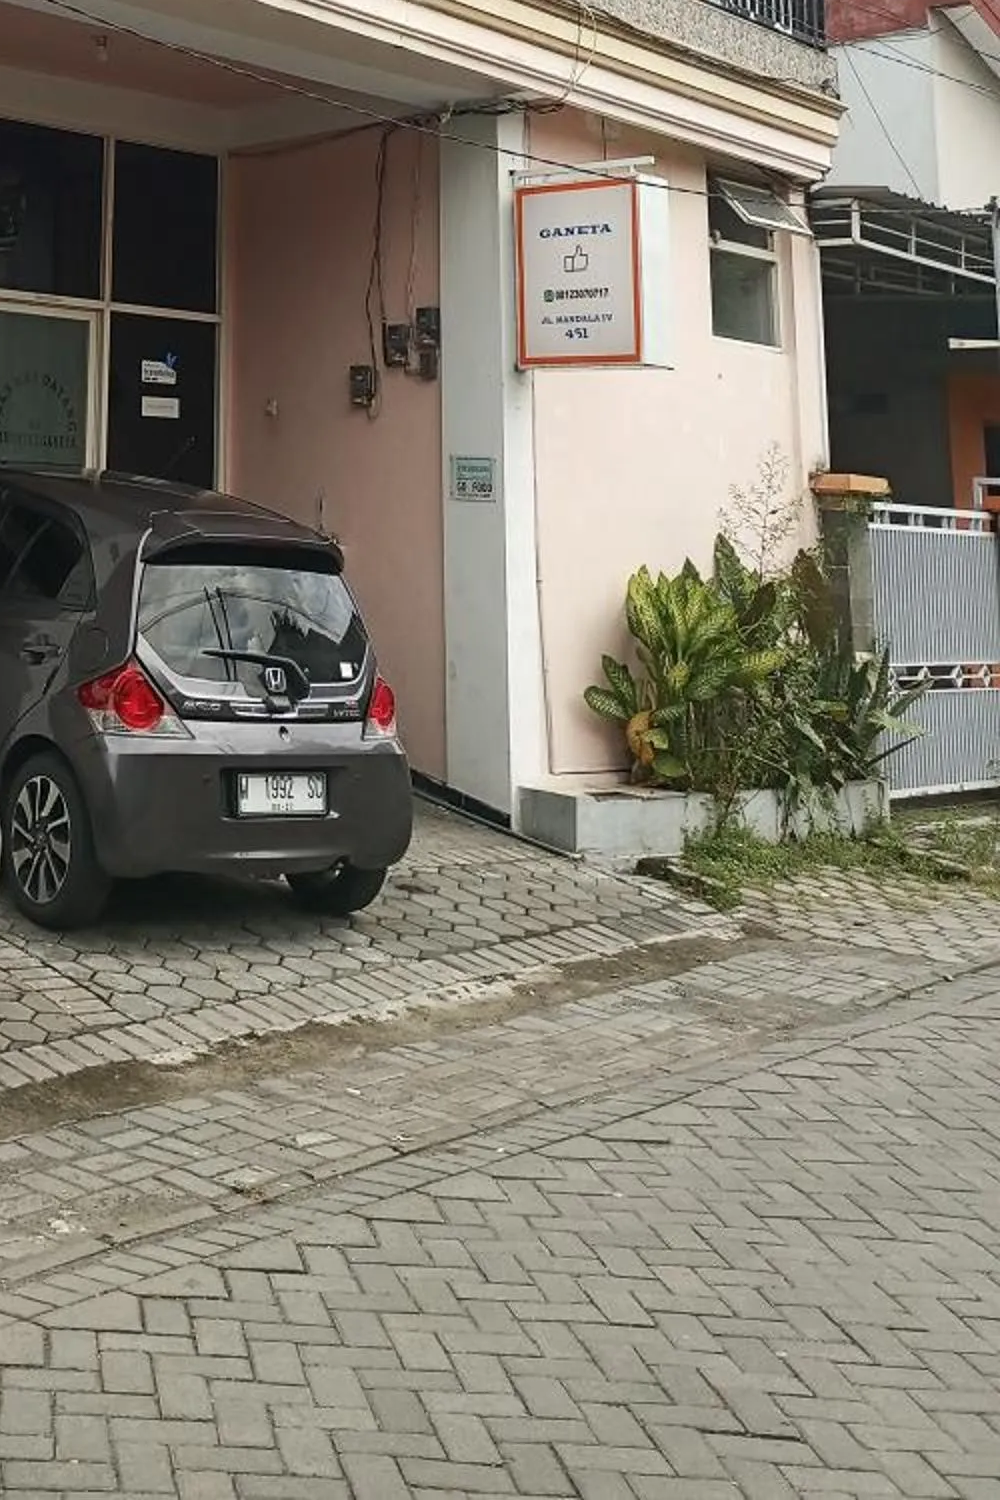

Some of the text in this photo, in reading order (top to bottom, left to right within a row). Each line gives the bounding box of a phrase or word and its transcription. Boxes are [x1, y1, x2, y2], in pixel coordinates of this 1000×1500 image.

[539, 223, 612, 239] GANETA
[565, 327, 590, 339] 451
[265, 774, 295, 800] 1992
